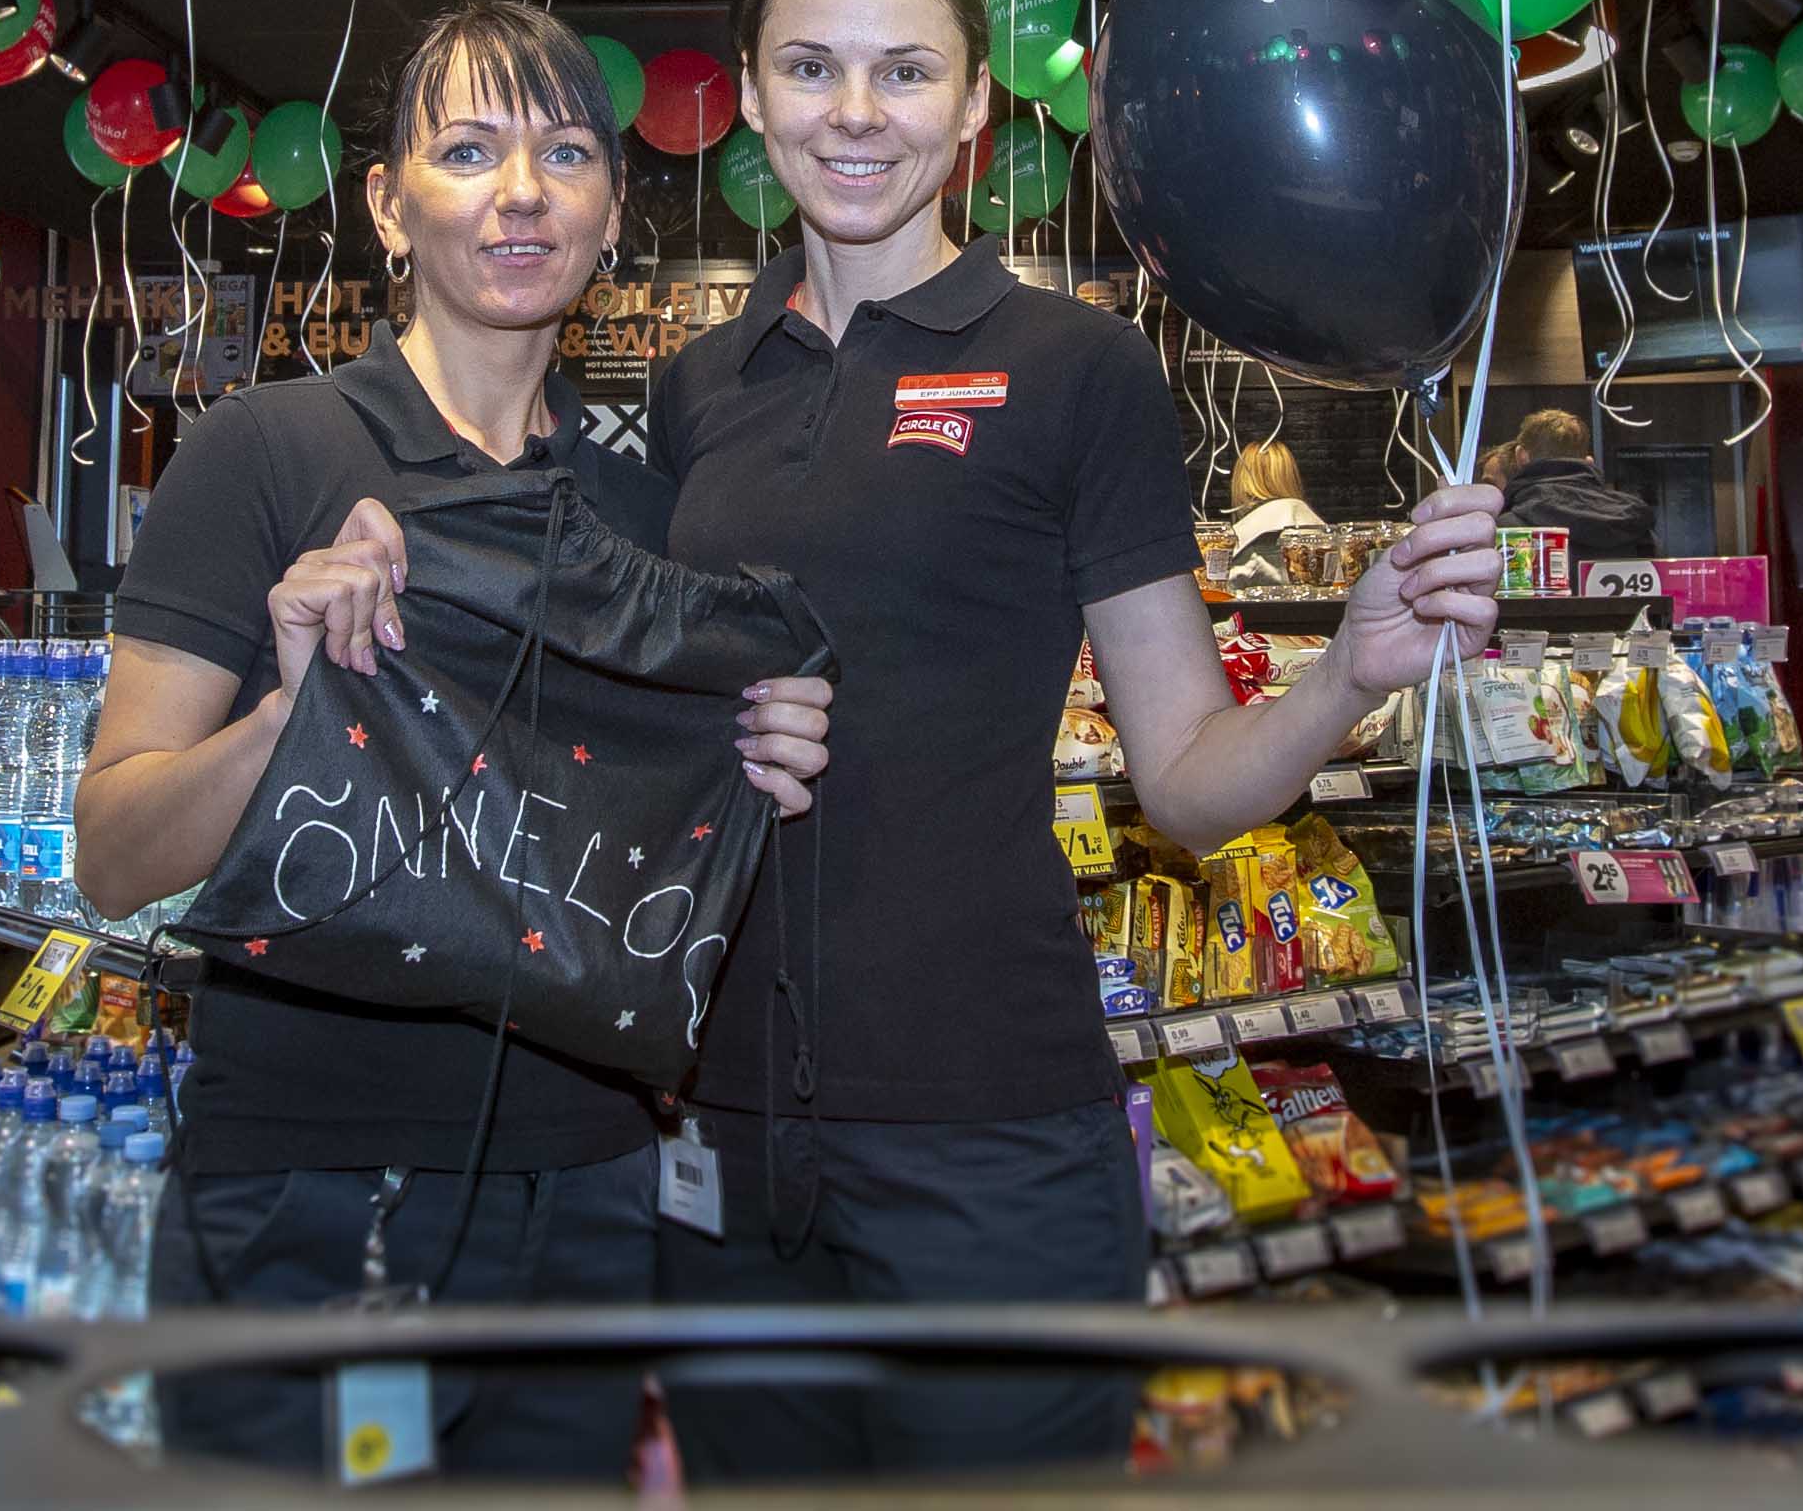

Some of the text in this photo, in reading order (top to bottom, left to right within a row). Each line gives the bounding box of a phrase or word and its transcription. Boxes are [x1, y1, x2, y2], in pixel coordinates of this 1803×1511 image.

[4, 285, 214, 320] MEHHIKO
[274, 280, 371, 315] HOT
[565, 274, 747, 316] ÕILEIV
[262, 322, 291, 357] &
[561, 323, 588, 358] &
[898, 419, 963, 440] CIRCLE K
[1083, 863, 1112, 875] VALUE
[1228, 847, 1254, 858] VALUE
[1151, 901, 1162, 946] EKSTRA
[1218, 903, 1243, 949] TUC
[1270, 897, 1293, 942] TUC
